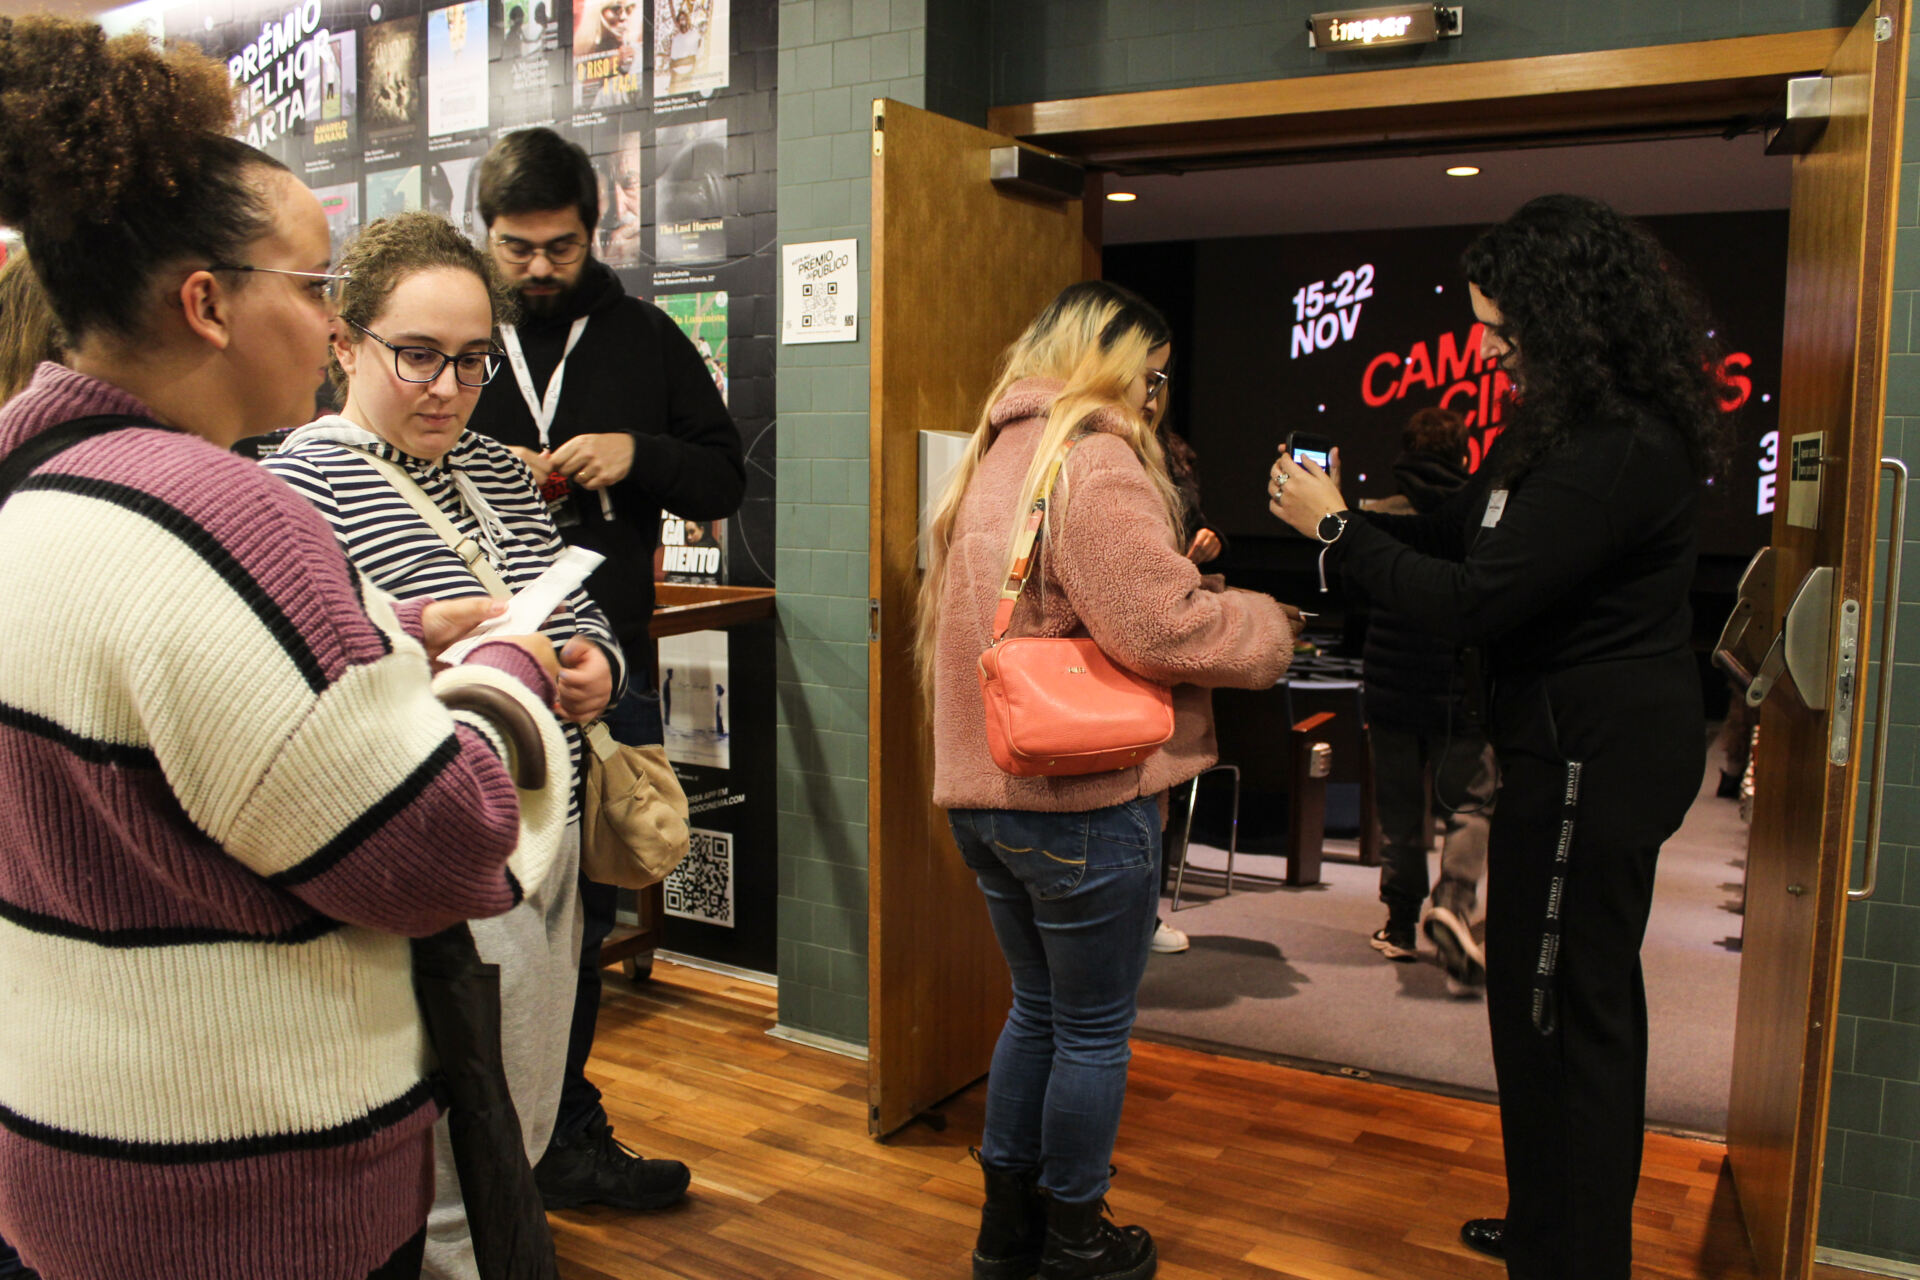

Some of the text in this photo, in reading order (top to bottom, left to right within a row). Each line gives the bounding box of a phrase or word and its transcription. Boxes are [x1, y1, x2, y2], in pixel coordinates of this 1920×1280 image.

[229, 0, 321, 88] PRÉMIO
[587, 58, 610, 79] RISO
[612, 56, 619, 75] E
[660, 220, 723, 234] The Last Harvest
[1292, 263, 1375, 322] 15-22
[1290, 302, 1363, 360] NOV
[662, 546, 720, 574] MENTO
[1564, 761, 1577, 806] COIMBRA
